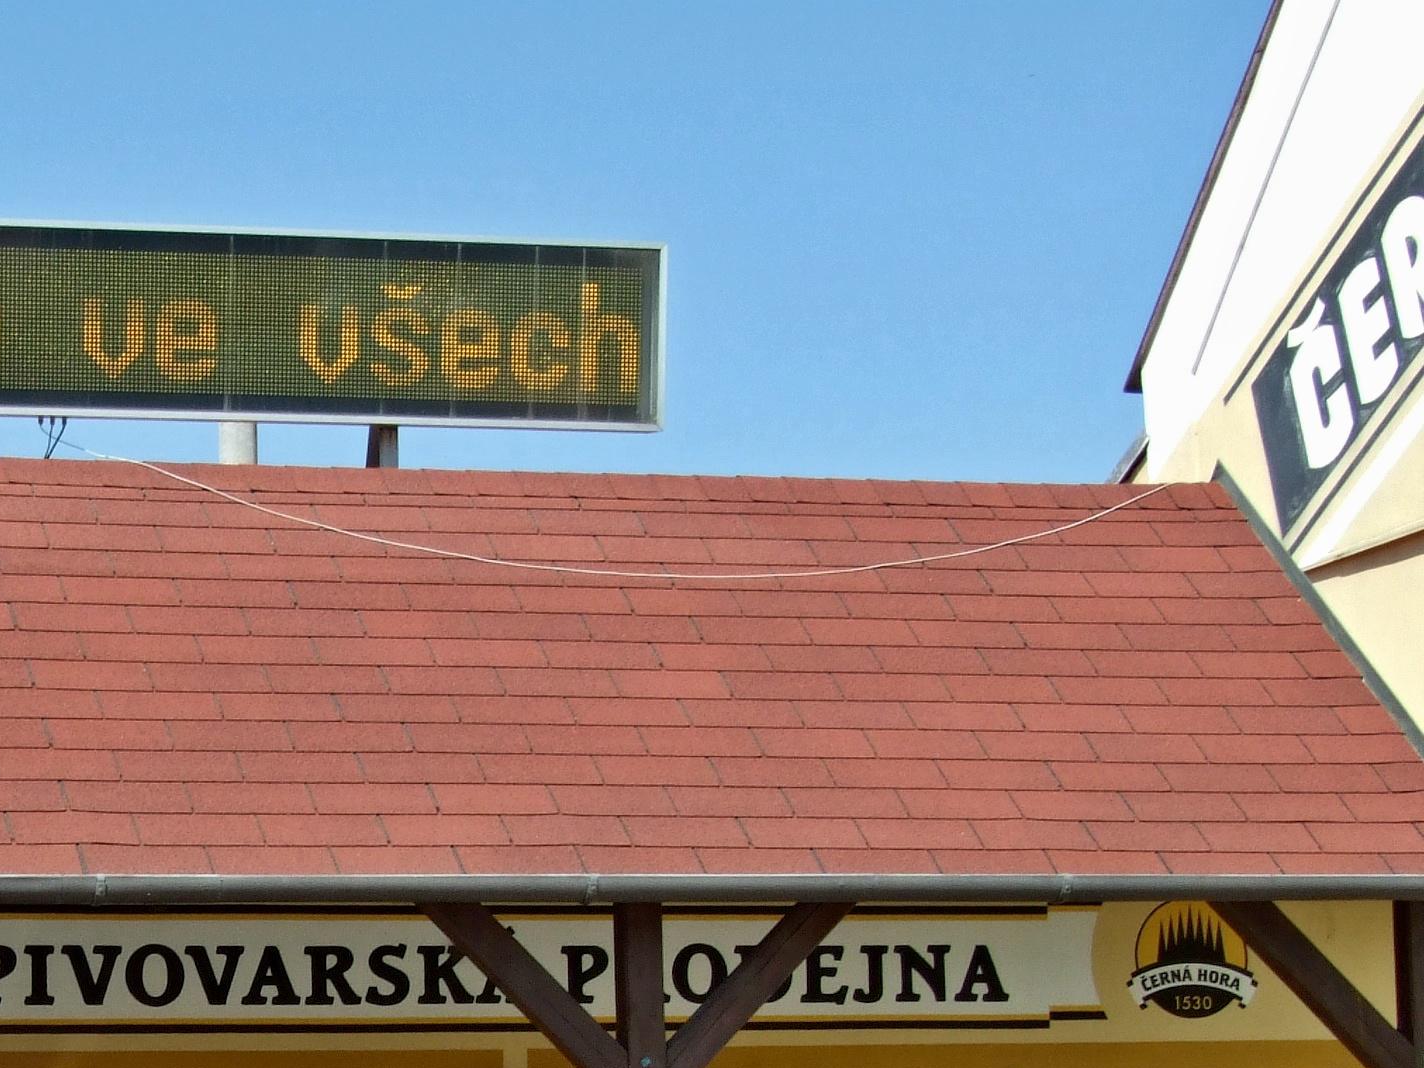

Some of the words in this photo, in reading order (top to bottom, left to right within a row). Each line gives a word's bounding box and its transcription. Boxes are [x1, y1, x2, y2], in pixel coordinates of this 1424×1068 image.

[83, 295, 219, 381] ve
[299, 283, 642, 394] všech
[560, 941, 1010, 1006] POEJNA
[1140, 965, 1192, 992] ČERNÁ
[1198, 968, 1240, 991] HORA
[1175, 996, 1212, 1010] 1530
